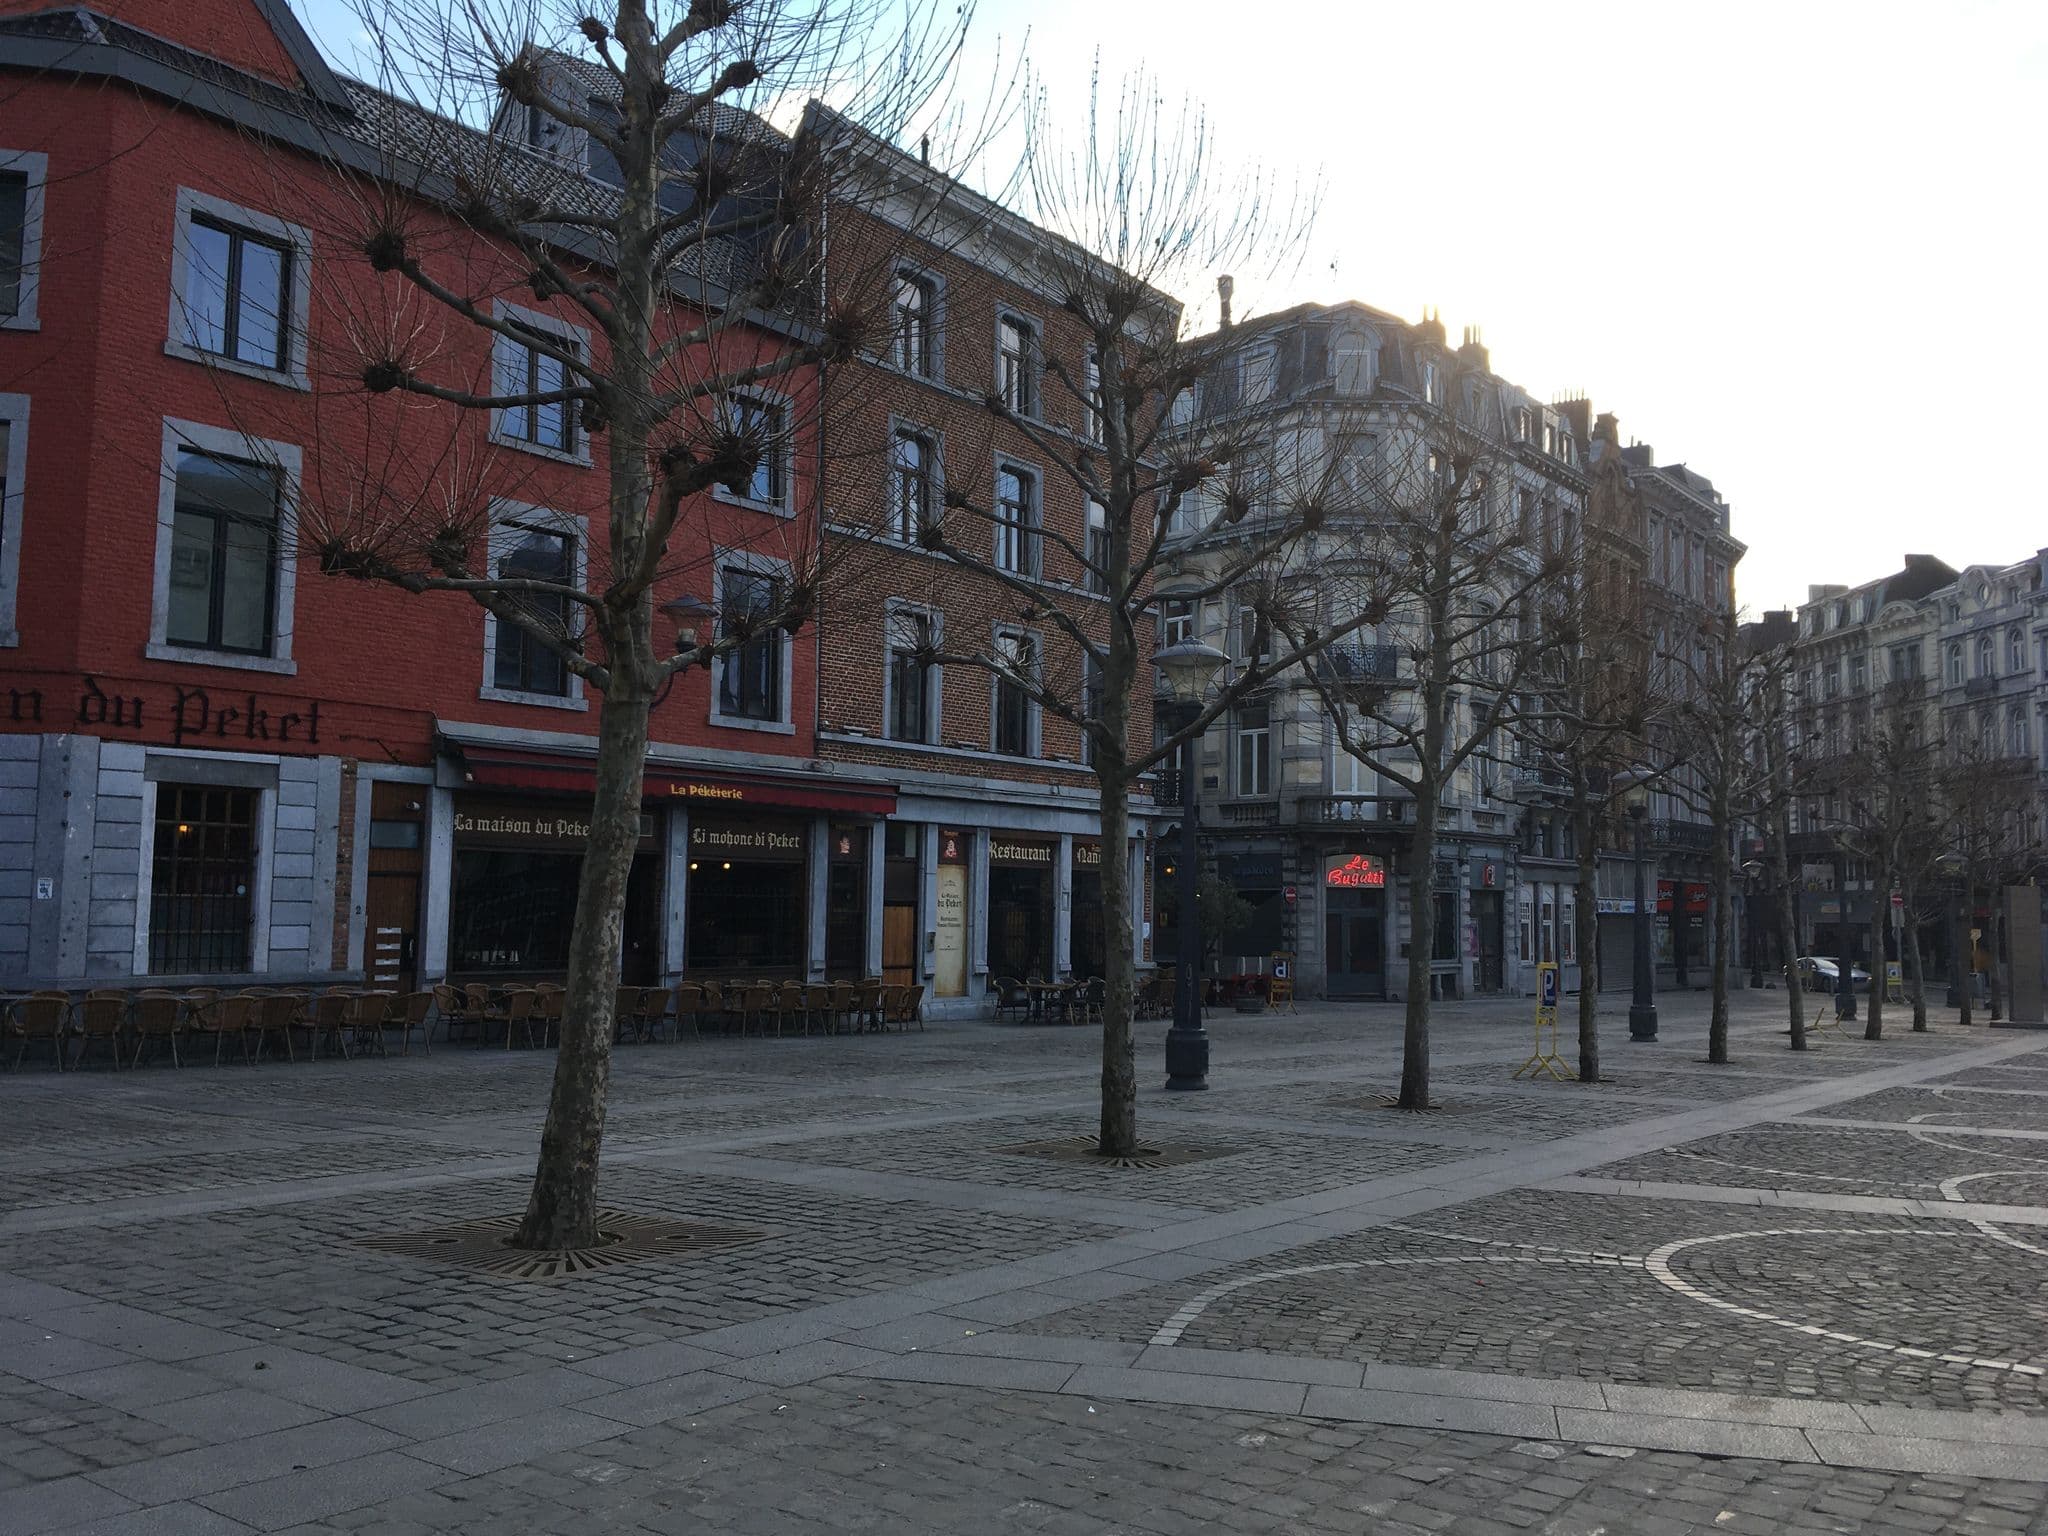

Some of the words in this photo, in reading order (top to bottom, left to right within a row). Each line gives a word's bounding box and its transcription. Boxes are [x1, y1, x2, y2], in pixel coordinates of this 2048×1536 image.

[77, 677, 147, 730] du
[170, 686, 320, 746] Peket
[671, 784, 686, 795] La
[453, 813, 473, 831] La
[477, 815, 531, 834] maison
[535, 818, 553, 836] du
[556, 818, 593, 838] Peke
[692, 828, 706, 844] Li
[755, 832, 766, 847] di
[768, 832, 801, 850] Peket
[989, 840, 1051, 862] Restaurant
[1345, 855, 1369, 871] Le
[1328, 869, 1385, 887] Bugatti
[355, 905, 362, 915] 2
